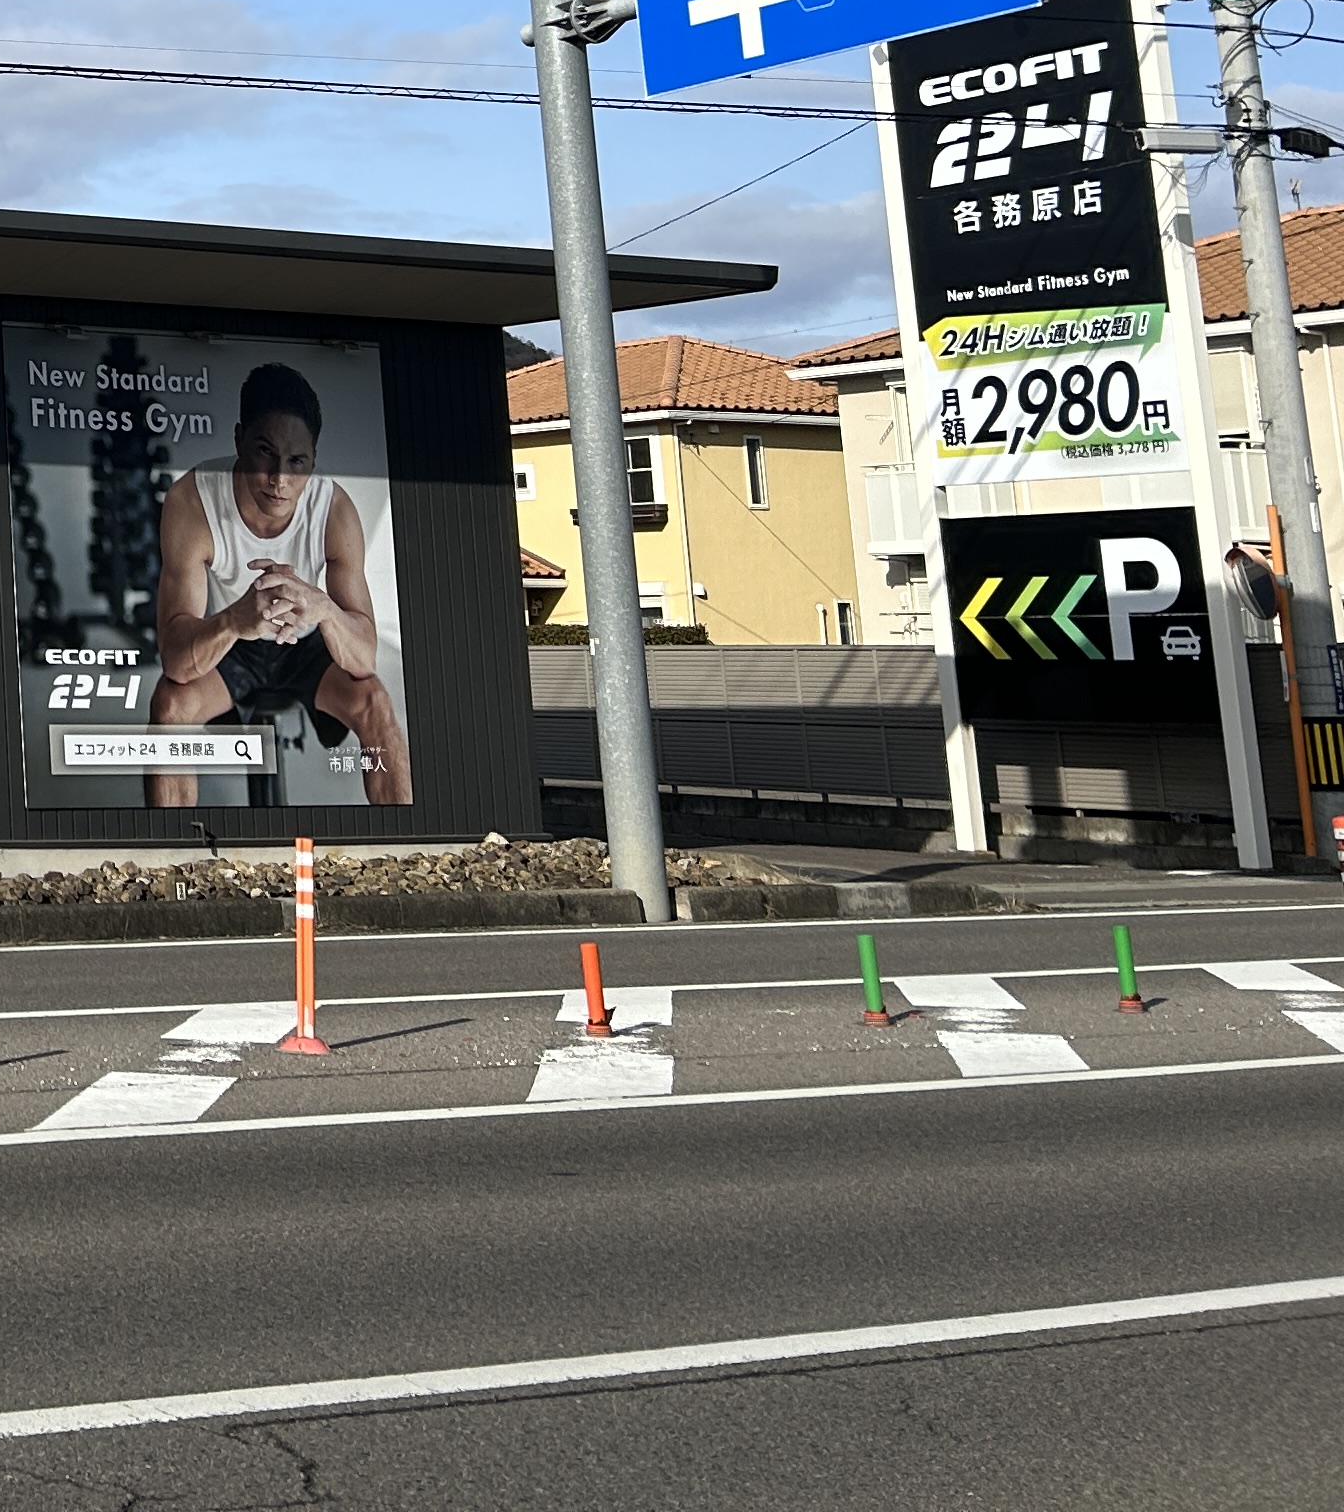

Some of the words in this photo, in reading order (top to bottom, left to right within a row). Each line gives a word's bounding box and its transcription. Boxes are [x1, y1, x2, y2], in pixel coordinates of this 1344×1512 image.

[918, 41, 1109, 107] ECOFIT
[929, 90, 1113, 189] 24
[953, 179, 1103, 235] 各務原店
[946, 289, 974, 303] New
[977, 276, 1033, 299] Standard
[1037, 274, 1089, 291] Fitness
[1093, 266, 1130, 287] Gym
[28, 360, 86, 387] New
[96, 364, 209, 394] Standard
[31, 397, 134, 432] Fitness
[145, 402, 213, 443] Gym
[940, 388, 967, 447] 月額
[1099, 536, 1182, 661] P
[45, 648, 141, 666] ECOFIT
[48, 674, 141, 709] 24
[74, 743, 157, 756] エコフィット24
[168, 742, 215, 757] 各務原店
